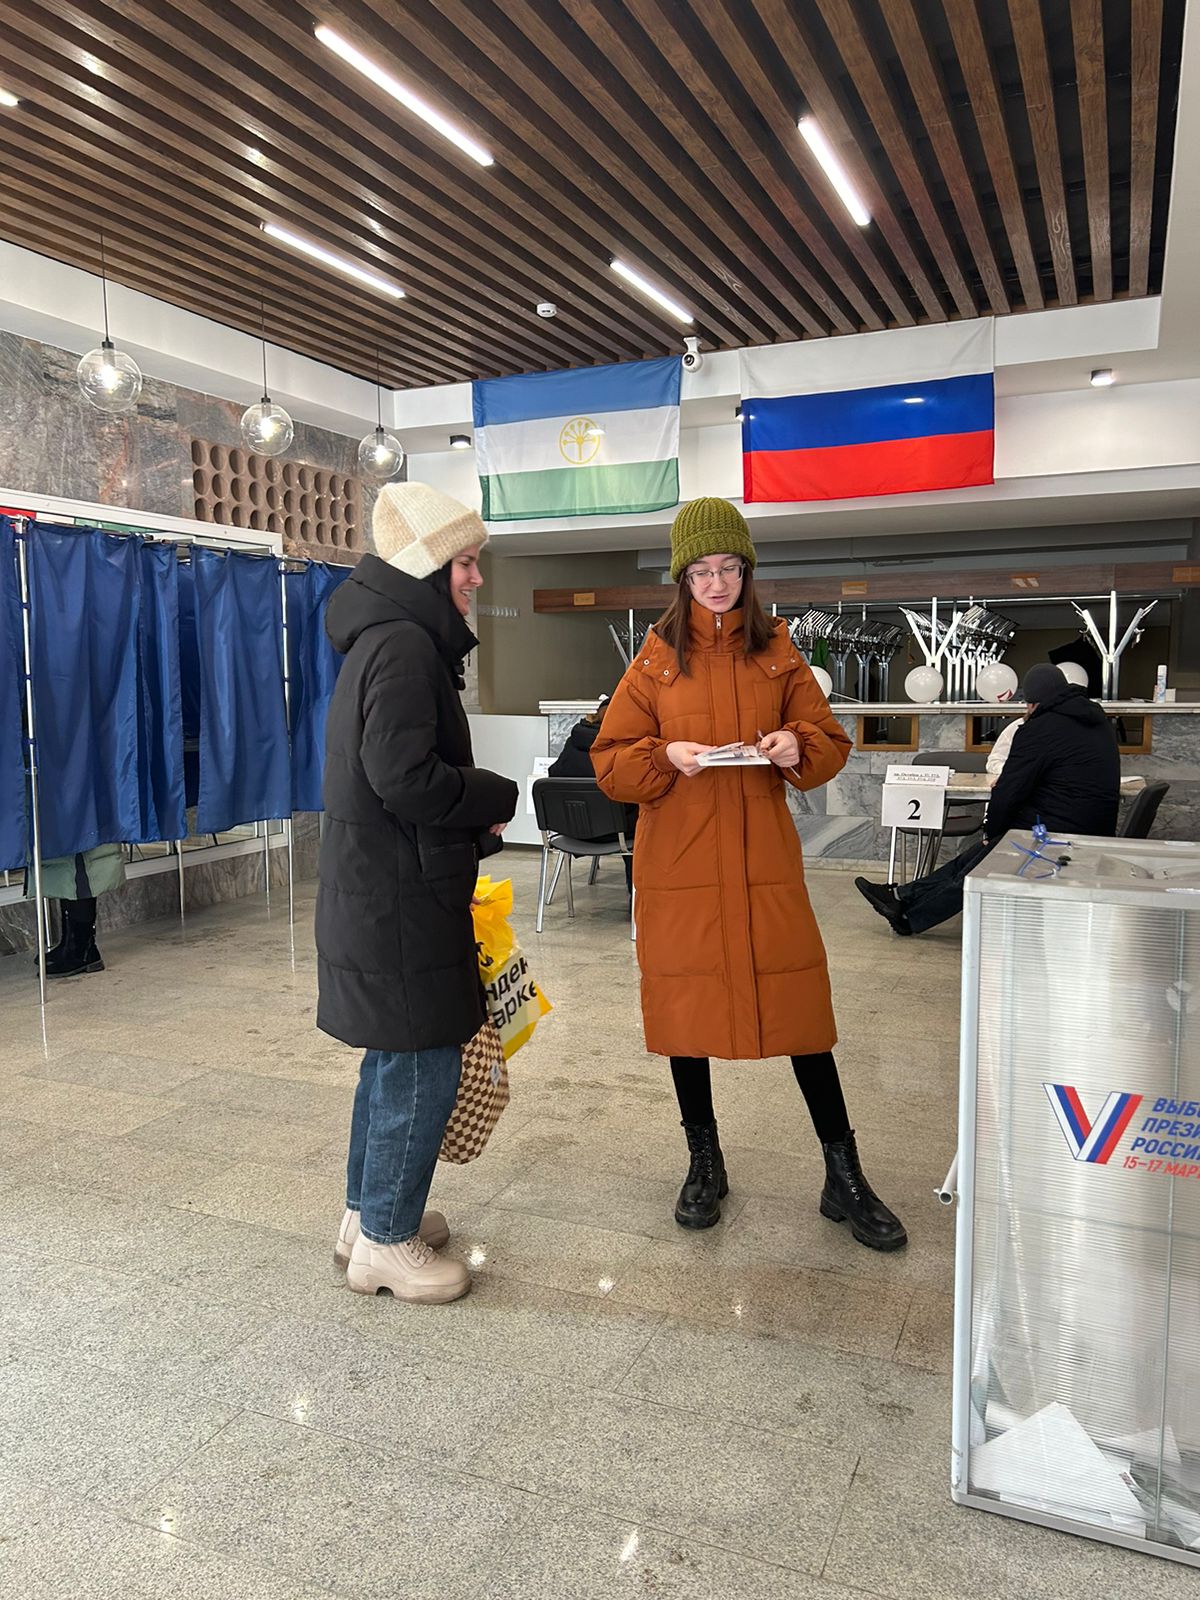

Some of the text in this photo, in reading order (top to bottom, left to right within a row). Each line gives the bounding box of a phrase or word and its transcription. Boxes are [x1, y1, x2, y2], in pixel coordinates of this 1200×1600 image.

[907, 799, 921, 820] 2
[1130, 1137, 1200, 1161] РОССИ
[1163, 1161, 1200, 1179] МАР
